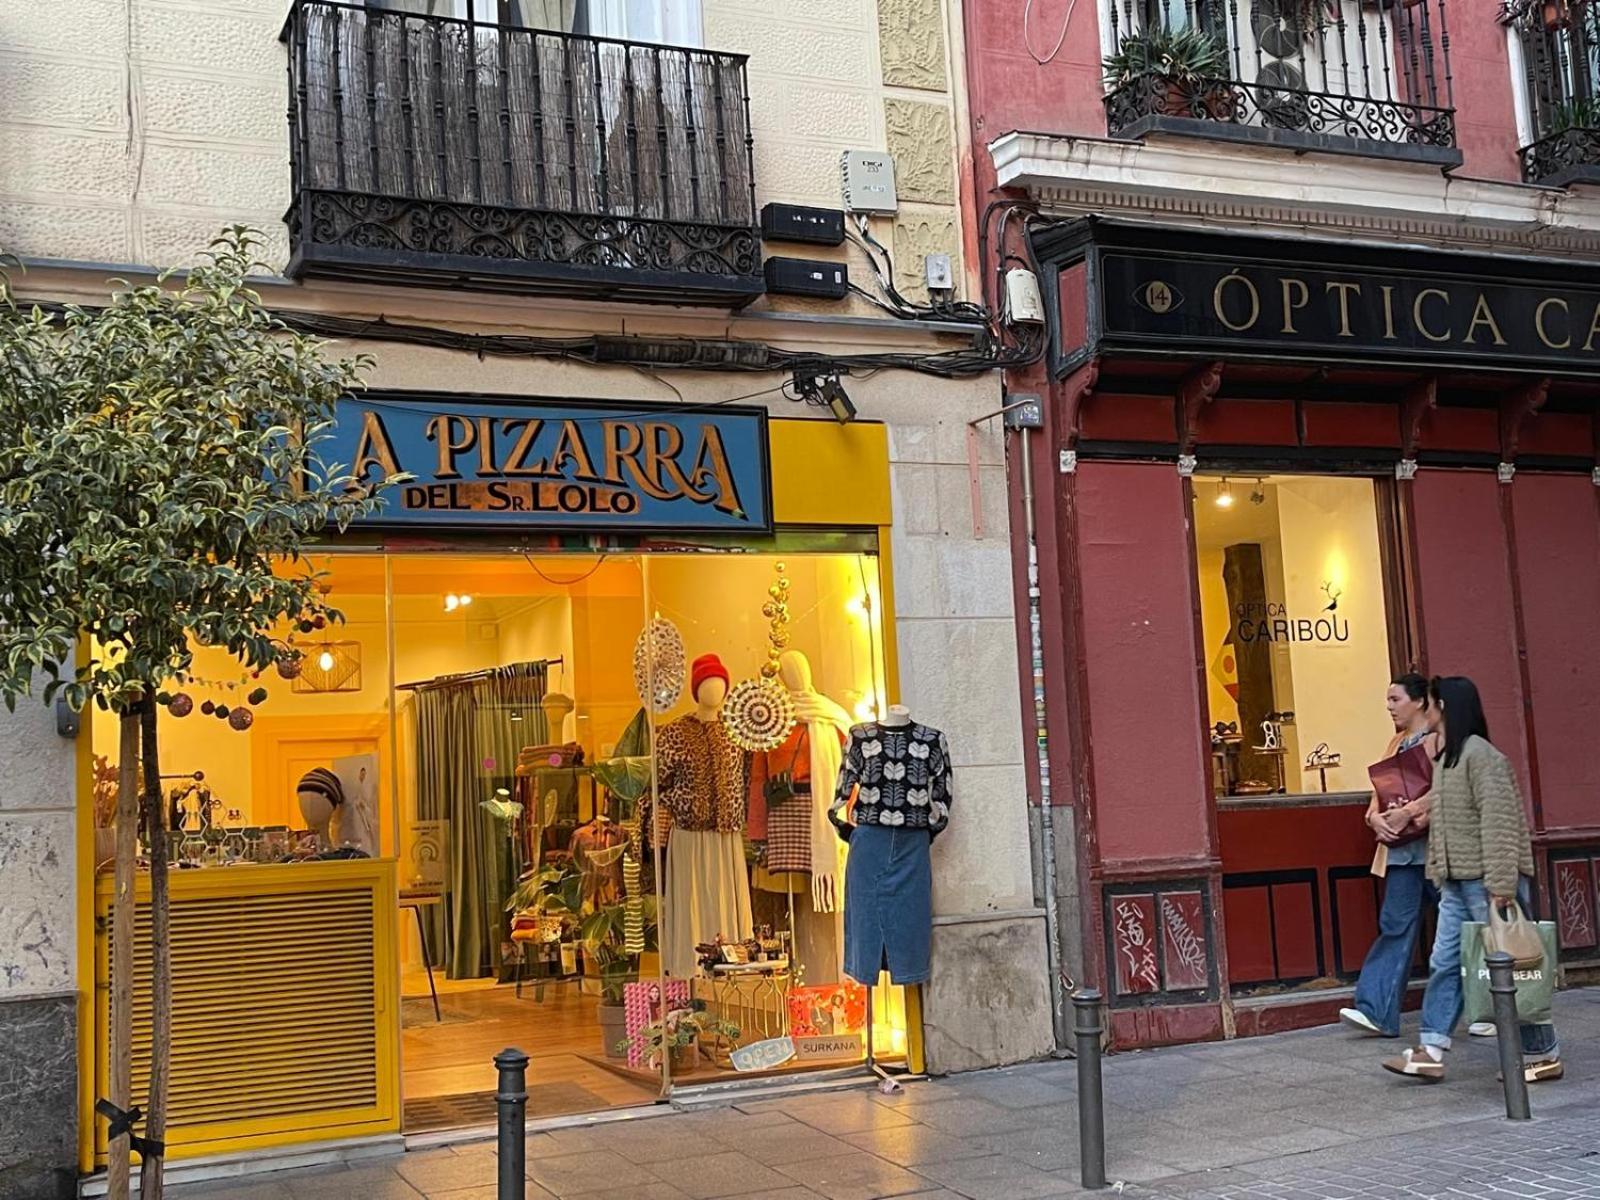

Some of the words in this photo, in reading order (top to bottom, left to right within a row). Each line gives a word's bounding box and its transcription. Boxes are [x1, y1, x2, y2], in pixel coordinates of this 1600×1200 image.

[1150, 287, 1169, 306] 14
[1213, 268, 1508, 346] ÓPTICA
[426, 413, 748, 520] PIZARRA
[406, 482, 471, 509] DEL
[1238, 614, 1349, 642] CARIBOU
[740, 1040, 789, 1065] OPEN
[803, 1042, 856, 1054] SURKANA
